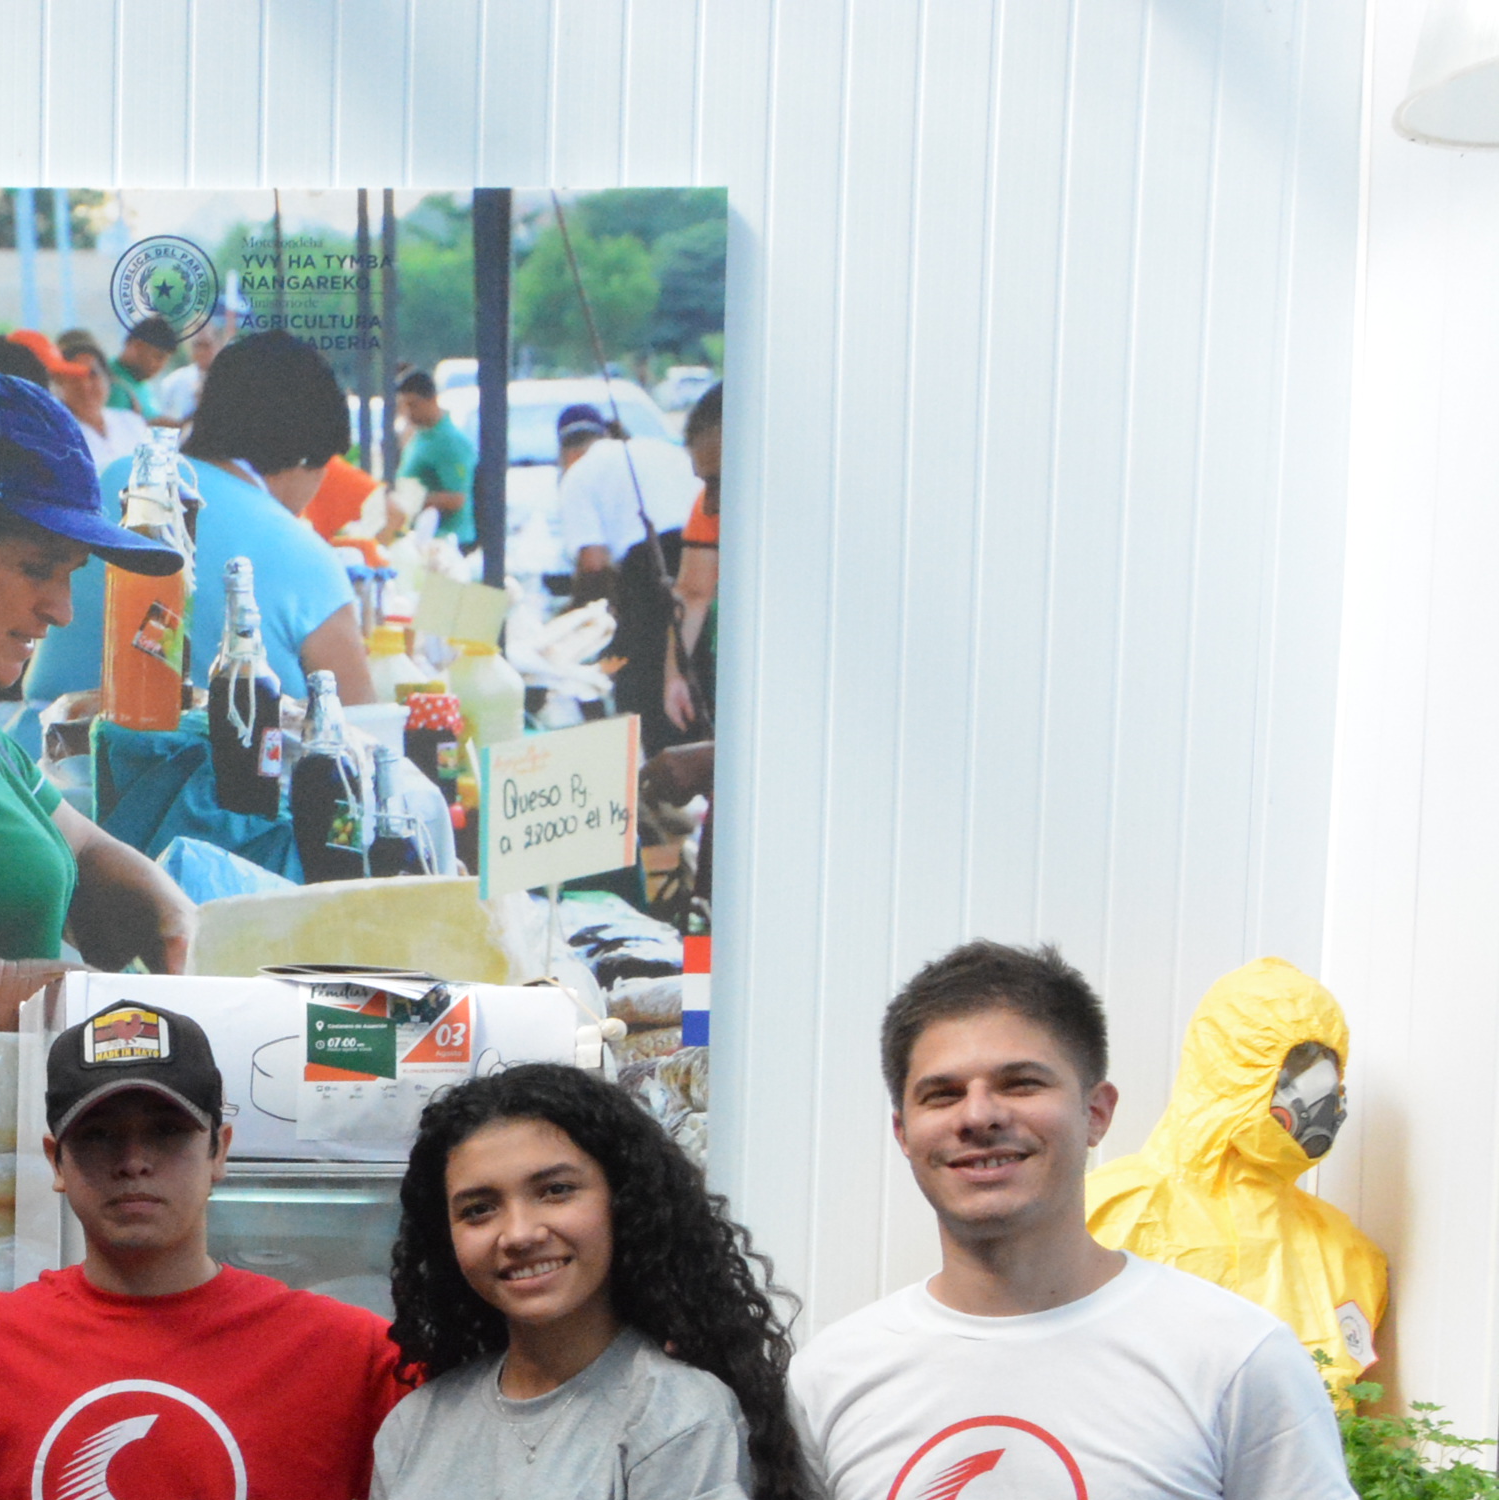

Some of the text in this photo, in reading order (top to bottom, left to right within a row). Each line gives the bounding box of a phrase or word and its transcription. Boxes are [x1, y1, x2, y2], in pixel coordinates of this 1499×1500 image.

[154, 246, 177, 258] DEL
[241, 254, 394, 270] YVY HA TYMBA
[241, 314, 382, 330] AGRICULTURA
[502, 777, 562, 821] Queso
[435, 1022, 468, 1047] 03
[95, 1049, 120, 1062] MADE
[121, 1049, 132, 1057] IN
